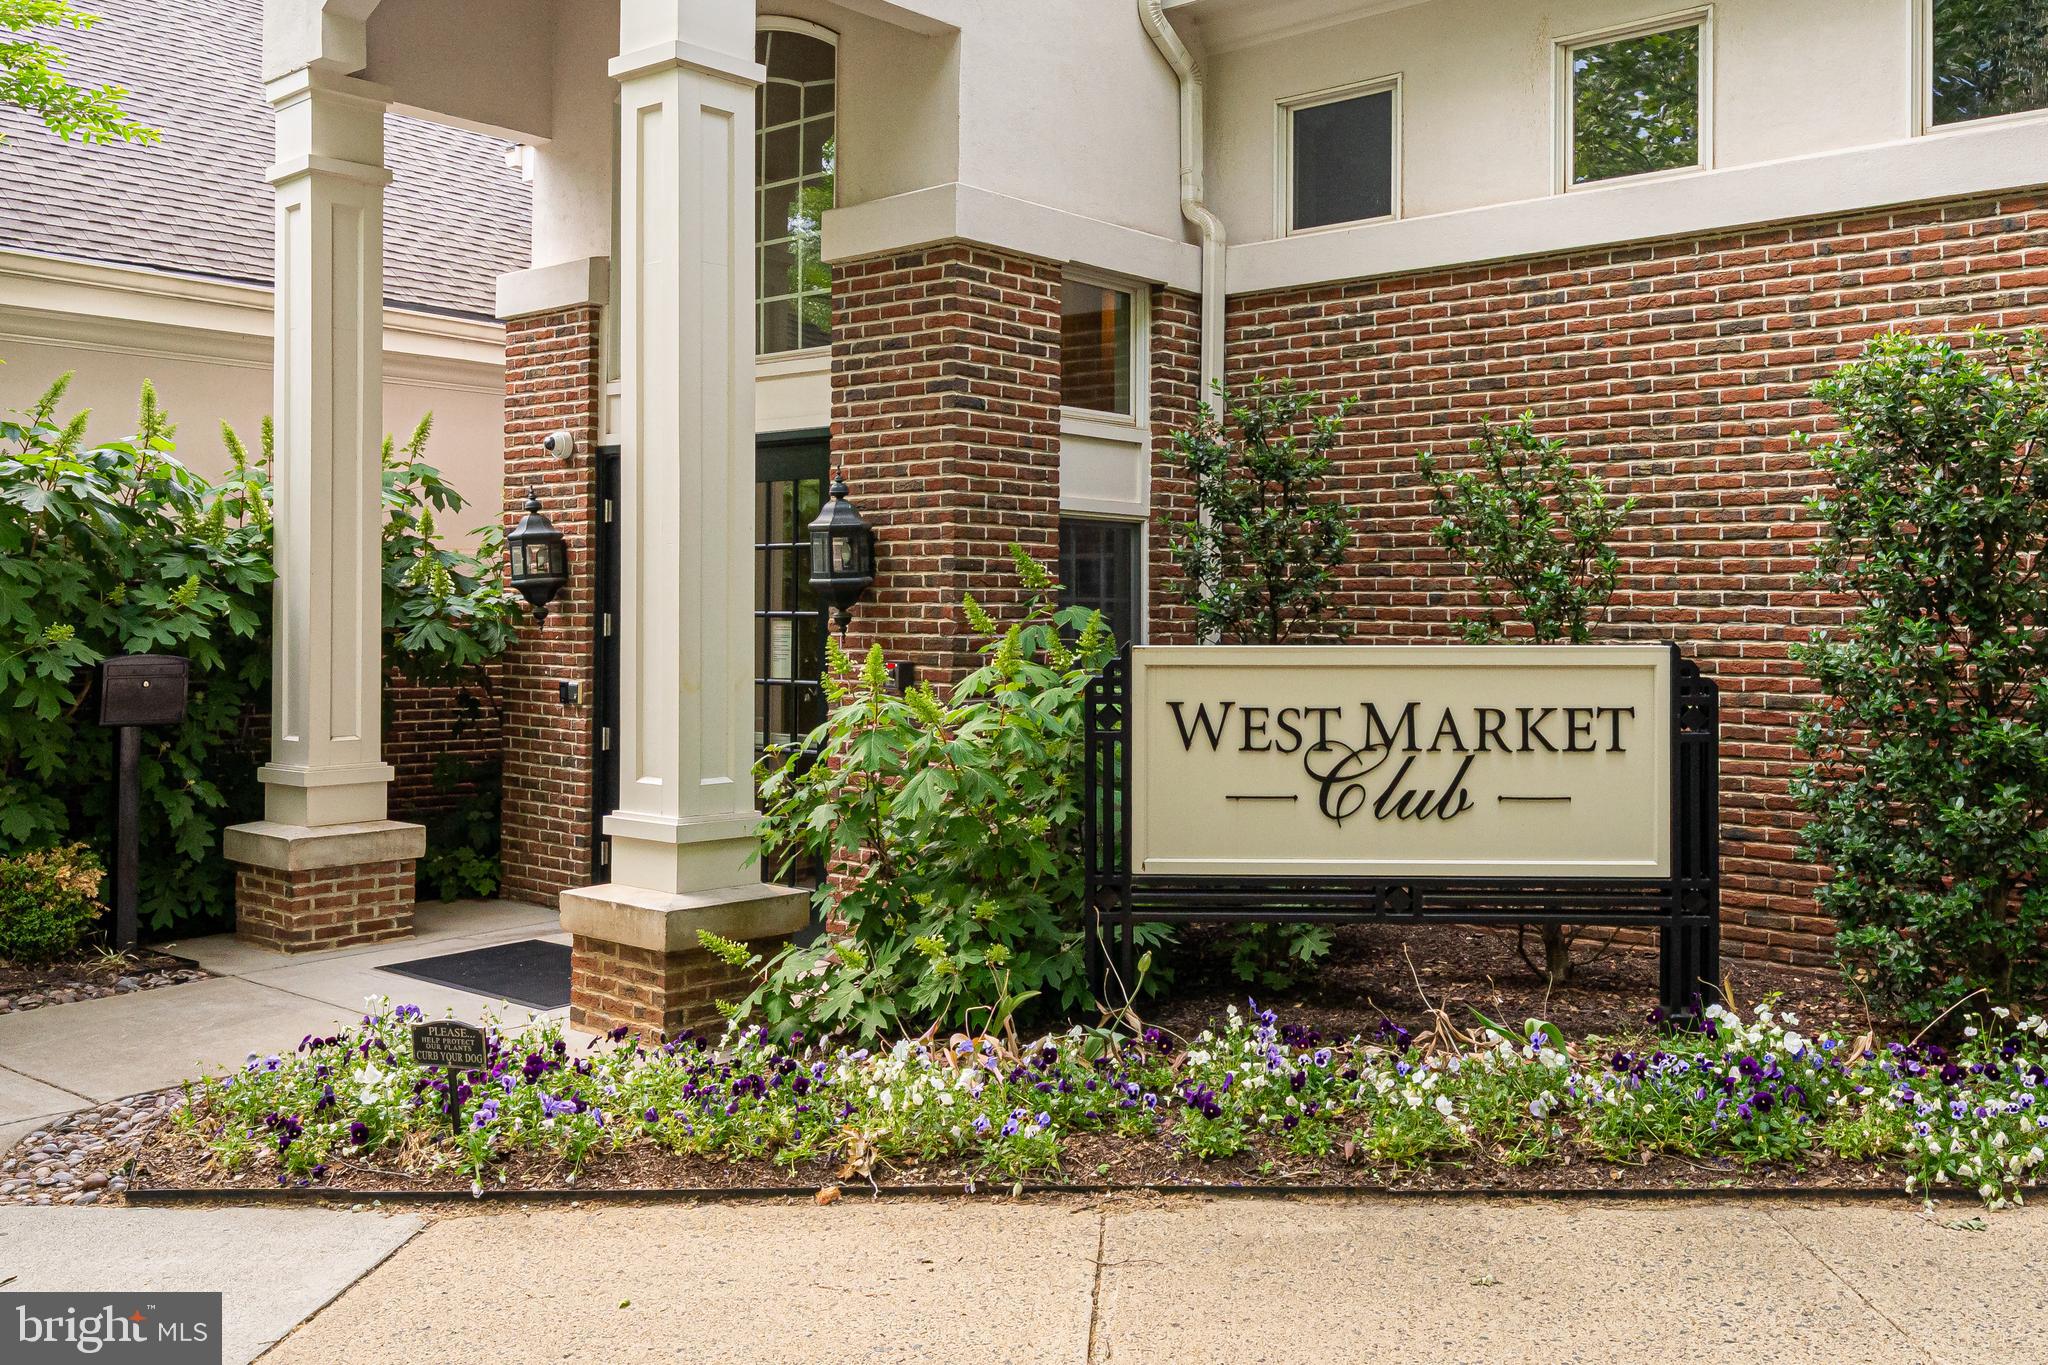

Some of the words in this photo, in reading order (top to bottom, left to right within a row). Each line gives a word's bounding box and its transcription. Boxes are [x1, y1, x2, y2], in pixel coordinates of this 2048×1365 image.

[1166, 701, 1341, 753] WEST
[1360, 702, 1635, 753] MARKET
[1303, 740, 1475, 828] Club
[417, 1051, 439, 1060] CURB
[440, 1052, 463, 1062] YOUR
[465, 1054, 482, 1063] DOG
[443, 1038, 474, 1046] PROTECT
